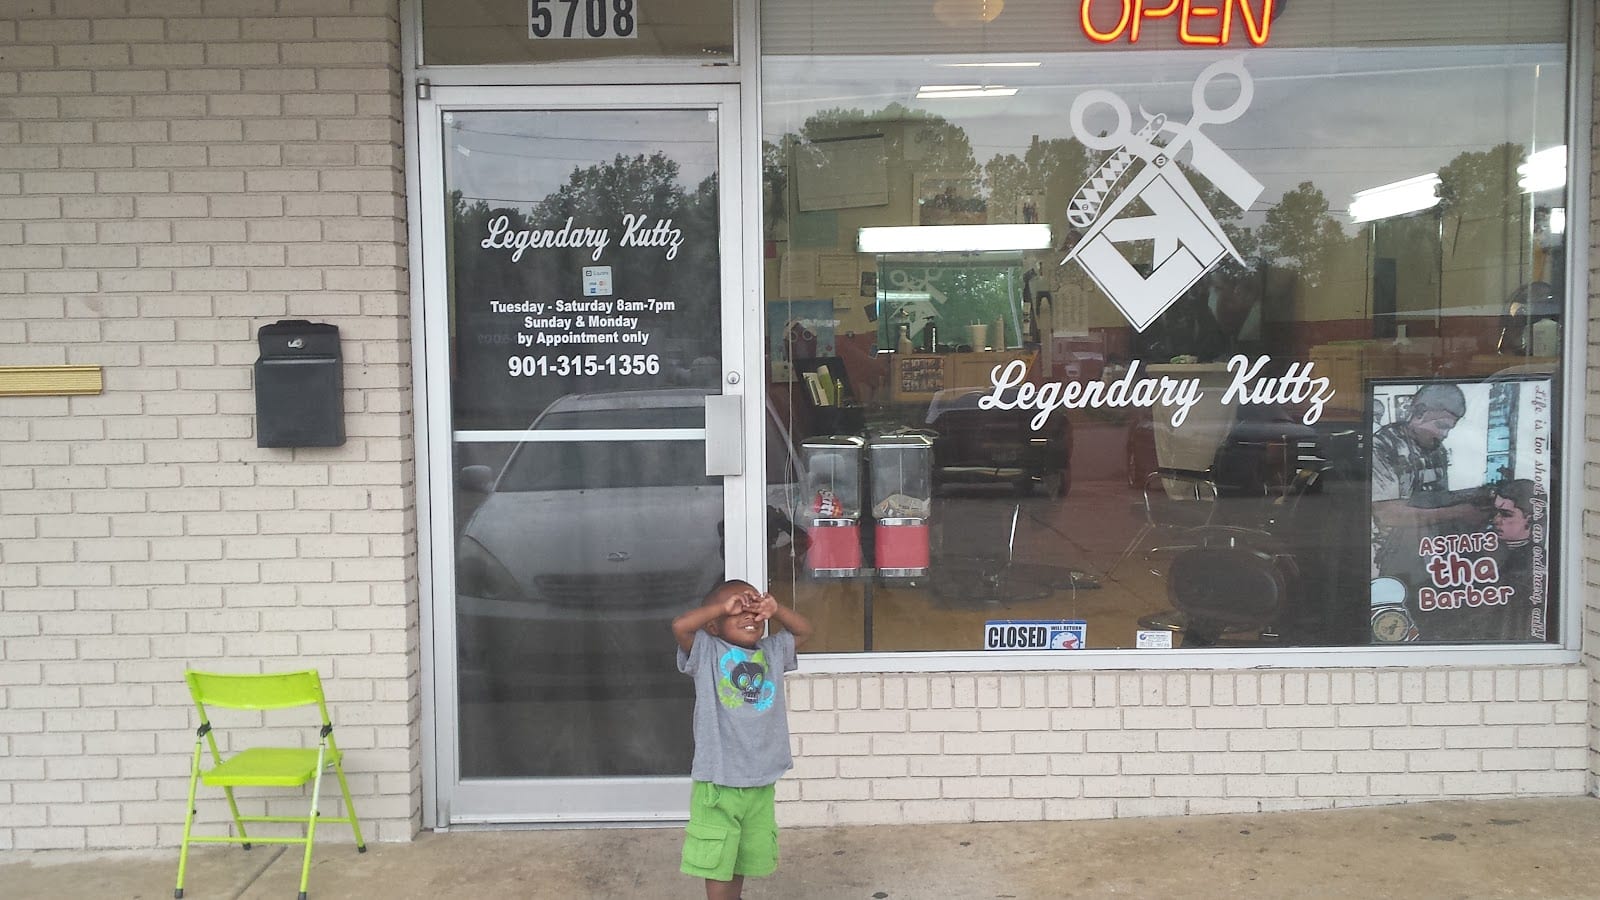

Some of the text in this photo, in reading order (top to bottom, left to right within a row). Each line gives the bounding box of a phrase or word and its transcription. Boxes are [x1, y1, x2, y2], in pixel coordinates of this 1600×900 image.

[531, 0, 634, 38] 5708
[1080, 0, 1274, 46] OPEN
[481, 214, 684, 263] Legendary Kuttz
[490, 301, 544, 315] Tuesday
[555, 300, 613, 314] Saturday
[616, 299, 675, 313] 8am-7pm
[524, 316, 638, 330] Sunday & Monday
[518, 332, 533, 346] by
[536, 332, 618, 346] Appointment
[622, 331, 649, 345] only
[508, 355, 659, 376] 901-315-1356
[978, 354, 1335, 431] Legendary Kuttz
[1535, 437, 1546, 455] too
[1533, 461, 1546, 495] short
[1530, 498, 1548, 520] for
[1419, 532, 1499, 555] ASTAT3
[1533, 524, 1544, 543] an
[1428, 553, 1500, 588] tha
[1419, 585, 1515, 611] Barber
[988, 626, 1047, 648] CLOSED
